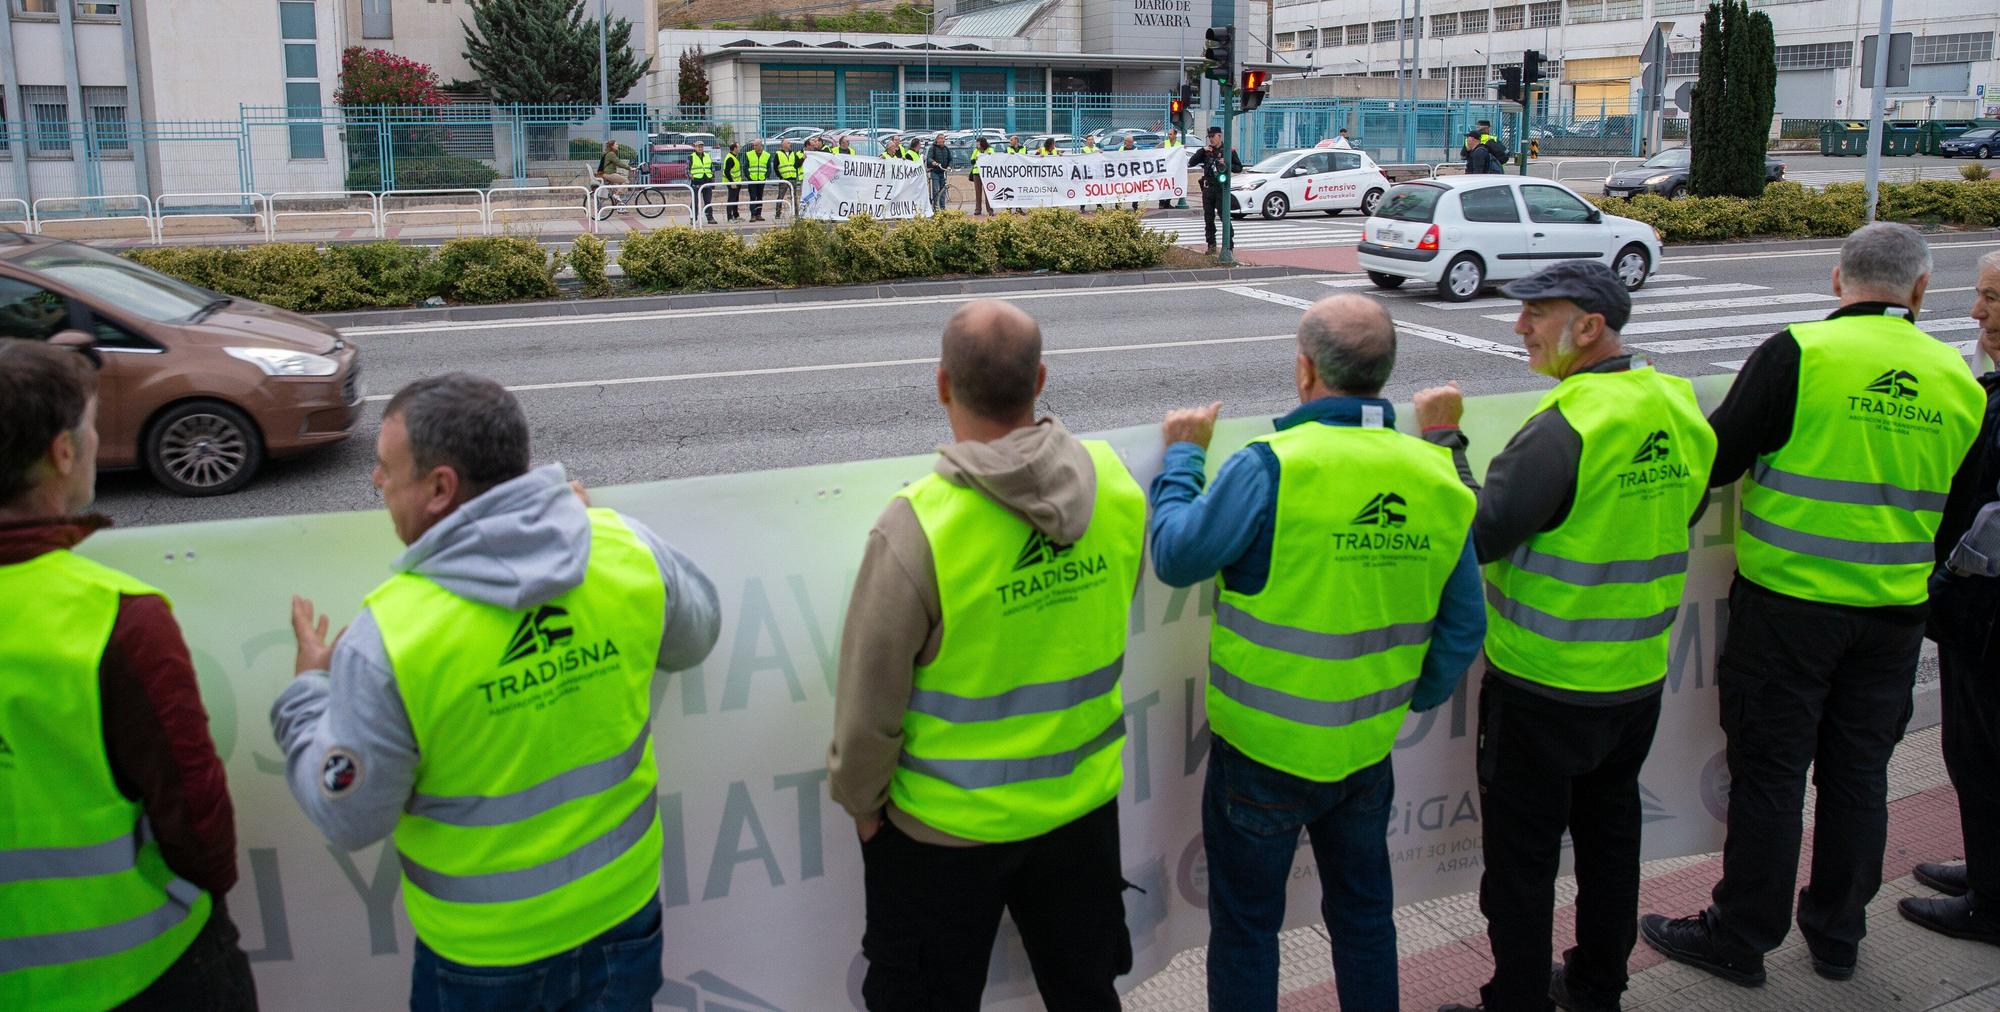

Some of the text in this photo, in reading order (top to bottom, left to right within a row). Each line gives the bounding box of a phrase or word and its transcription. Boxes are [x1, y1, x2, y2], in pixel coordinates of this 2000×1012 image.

[1134, 0, 1191, 11] DIARIO DE
[1134, 13, 1191, 27] NAVARRA
[844, 161, 886, 179] BALDINTZA
[980, 158, 1167, 180] TRANSPORTISTAS AL BORDE
[1085, 177, 1175, 197] SOLUCIONES YA!
